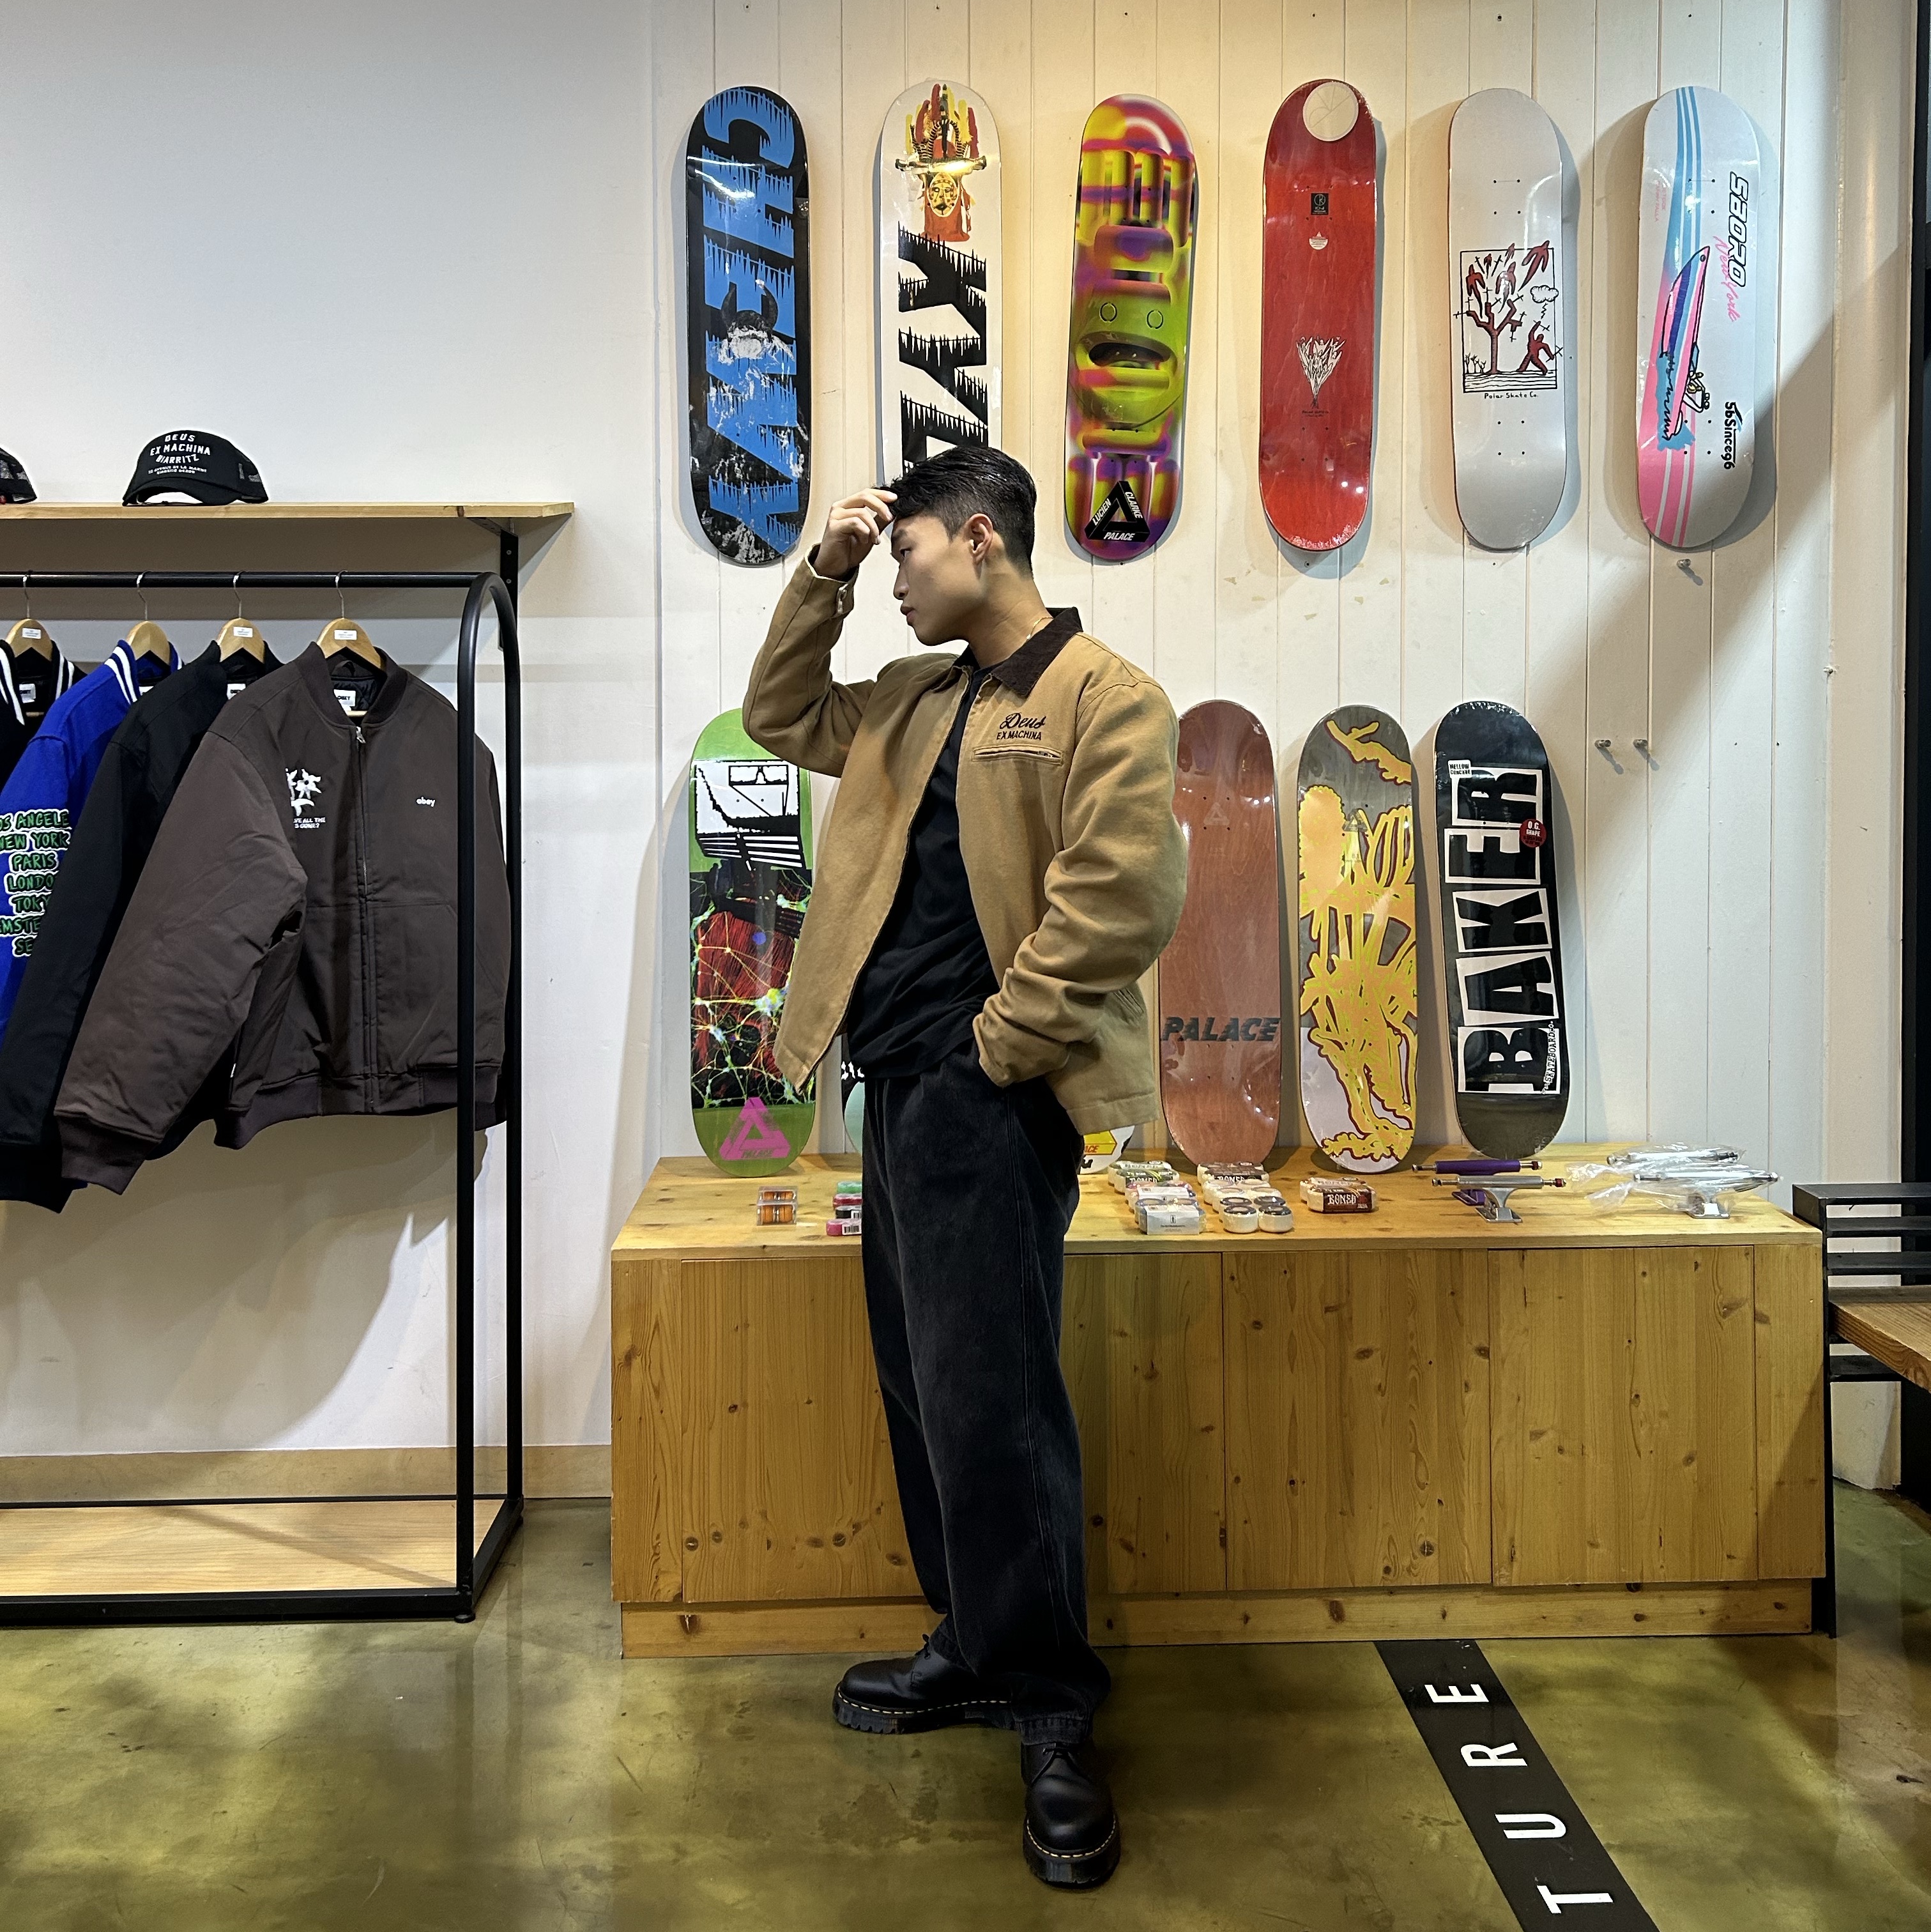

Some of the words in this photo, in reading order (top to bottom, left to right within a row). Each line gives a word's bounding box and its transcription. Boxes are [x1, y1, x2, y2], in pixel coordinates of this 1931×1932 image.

[1721, 281, 1741, 322] York
[701, 87, 800, 555] CHEWY
[897, 221, 989, 476] KYL
[164, 433, 196, 442] DEUS
[149, 446, 162, 456] EX
[163, 443, 211, 456] MACHINA
[155, 454, 200, 464] BIARRITZ
[1092, 498, 1112, 526] LUCIEN
[1124, 491, 1143, 519] CLARKE
[1103, 532, 1136, 541] PALACE
[999, 712, 1047, 729] Deus
[996, 731, 1007, 740] EX
[1007, 730, 1042, 741] MACHINA
[416, 797, 436, 807] obey
[31, 831, 68, 849] YORK
[11, 852, 57, 871] PARIS
[1444, 766, 1561, 1094] BAKER
[1160, 1016, 1281, 1041] PALACE
[1543, 1032, 1557, 1084] SKATEBOARD
